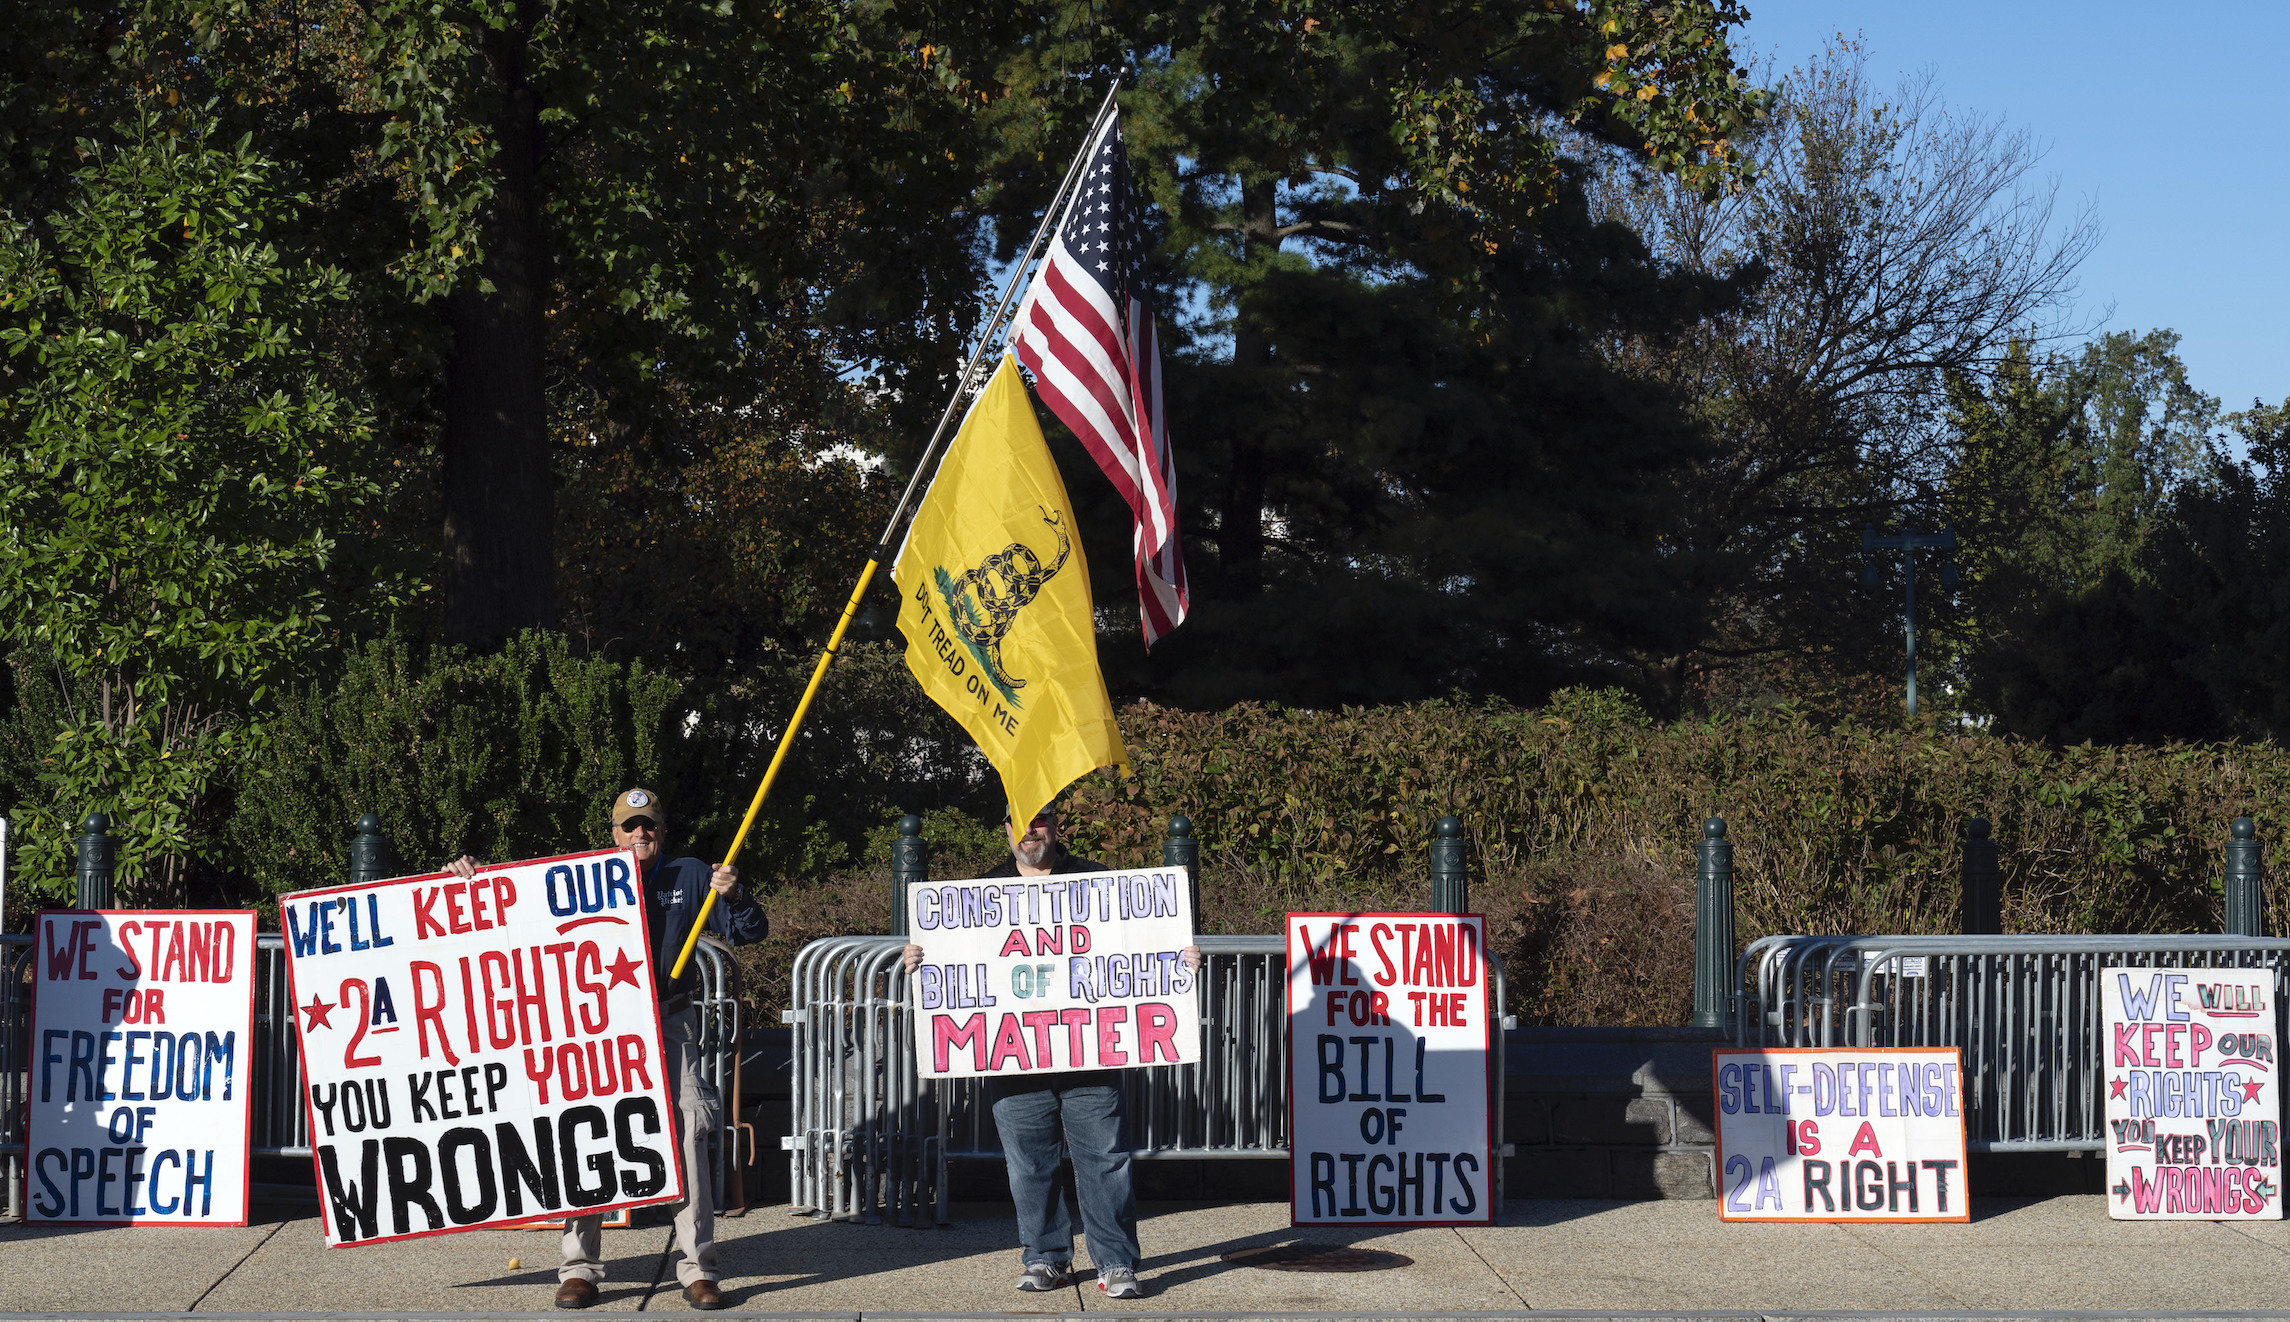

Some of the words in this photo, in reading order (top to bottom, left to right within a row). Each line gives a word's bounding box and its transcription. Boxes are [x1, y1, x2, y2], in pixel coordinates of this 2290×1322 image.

[928, 618, 965, 676] TREAD
[966, 675, 990, 705] ON
[993, 702, 1019, 737] ME
[286, 893, 394, 958] WE'LL
[412, 876, 517, 940] KEEP
[546, 857, 636, 917] OUR
[916, 873, 1178, 931] CONSTITUTION
[45, 920, 99, 980] WE
[117, 920, 235, 984] STAND
[999, 924, 1092, 958] AND
[1300, 922, 1358, 987] WE
[1370, 922, 1477, 988] STAND
[103, 988, 165, 1024] FOR
[410, 940, 609, 1066] RIGHTS
[921, 964, 996, 1009] BILL
[1011, 964, 1054, 999] OF
[1069, 949, 1193, 1003] RIGHTS
[1327, 990, 1390, 1028] FOR
[1408, 991, 1467, 1027] THE
[2118, 973, 2190, 1021] WE
[2197, 984, 2266, 1011] WILL
[42, 1030, 235, 1102] FREEDOM
[933, 1002, 1179, 1073] MATTER
[2114, 1023, 2213, 1068] KEEP
[2218, 1033, 2273, 1064] OUR
[312, 1077, 391, 1136] YOU
[408, 1062, 508, 1123] KEEP
[524, 1033, 653, 1105] YOUR
[1318, 1033, 1445, 1104] BILL
[1719, 1062, 1959, 1118] SELF-DEFENSE
[2129, 1070, 2242, 1119] RIGHTS
[109, 1106, 155, 1144] OF
[1360, 1108, 1406, 1145] OF
[1787, 1120, 1820, 1156] IS
[1848, 1121, 1883, 1158] A
[2111, 1119, 2155, 1145] YOU
[2155, 1134, 2206, 1165] KEEP
[2206, 1119, 2278, 1167] YOUR
[34, 1146, 214, 1217] SPEECH
[318, 1096, 665, 1242] WRONGS
[1311, 1152, 1479, 1218] RIGHTS
[1725, 1154, 1783, 1214] 2A
[1803, 1159, 1958, 1214] RIGHT
[2131, 1167, 2264, 1214] WRONGS
